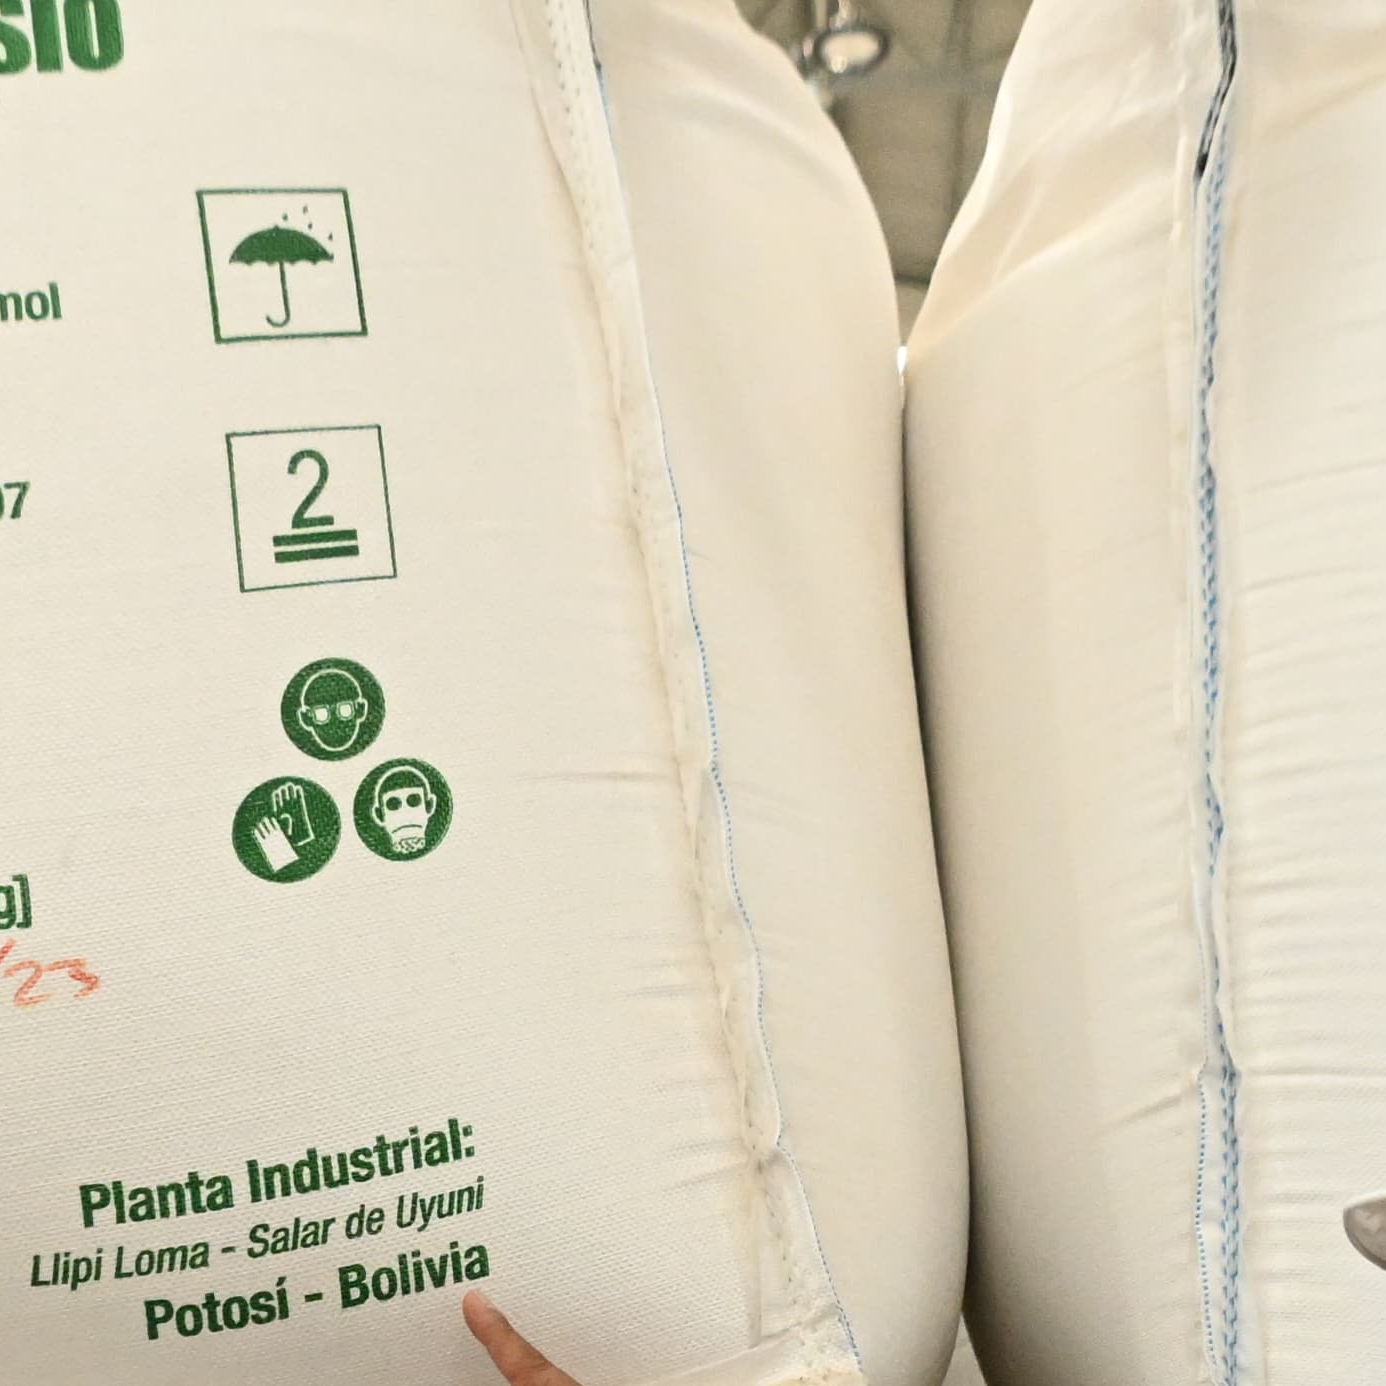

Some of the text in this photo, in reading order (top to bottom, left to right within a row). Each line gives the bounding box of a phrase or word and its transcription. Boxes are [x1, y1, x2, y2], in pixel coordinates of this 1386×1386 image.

[79, 1117, 476, 1228] Planta Industrial:
[31, 1248, 103, 1291] Llipi
[114, 1242, 209, 1279] Loma
[247, 1217, 336, 1259] Salar
[345, 1204, 385, 1239] de
[396, 1176, 484, 1232] Uyuni
[144, 1276, 289, 1340] Potosí
[338, 1241, 489, 1309] Bolivia
